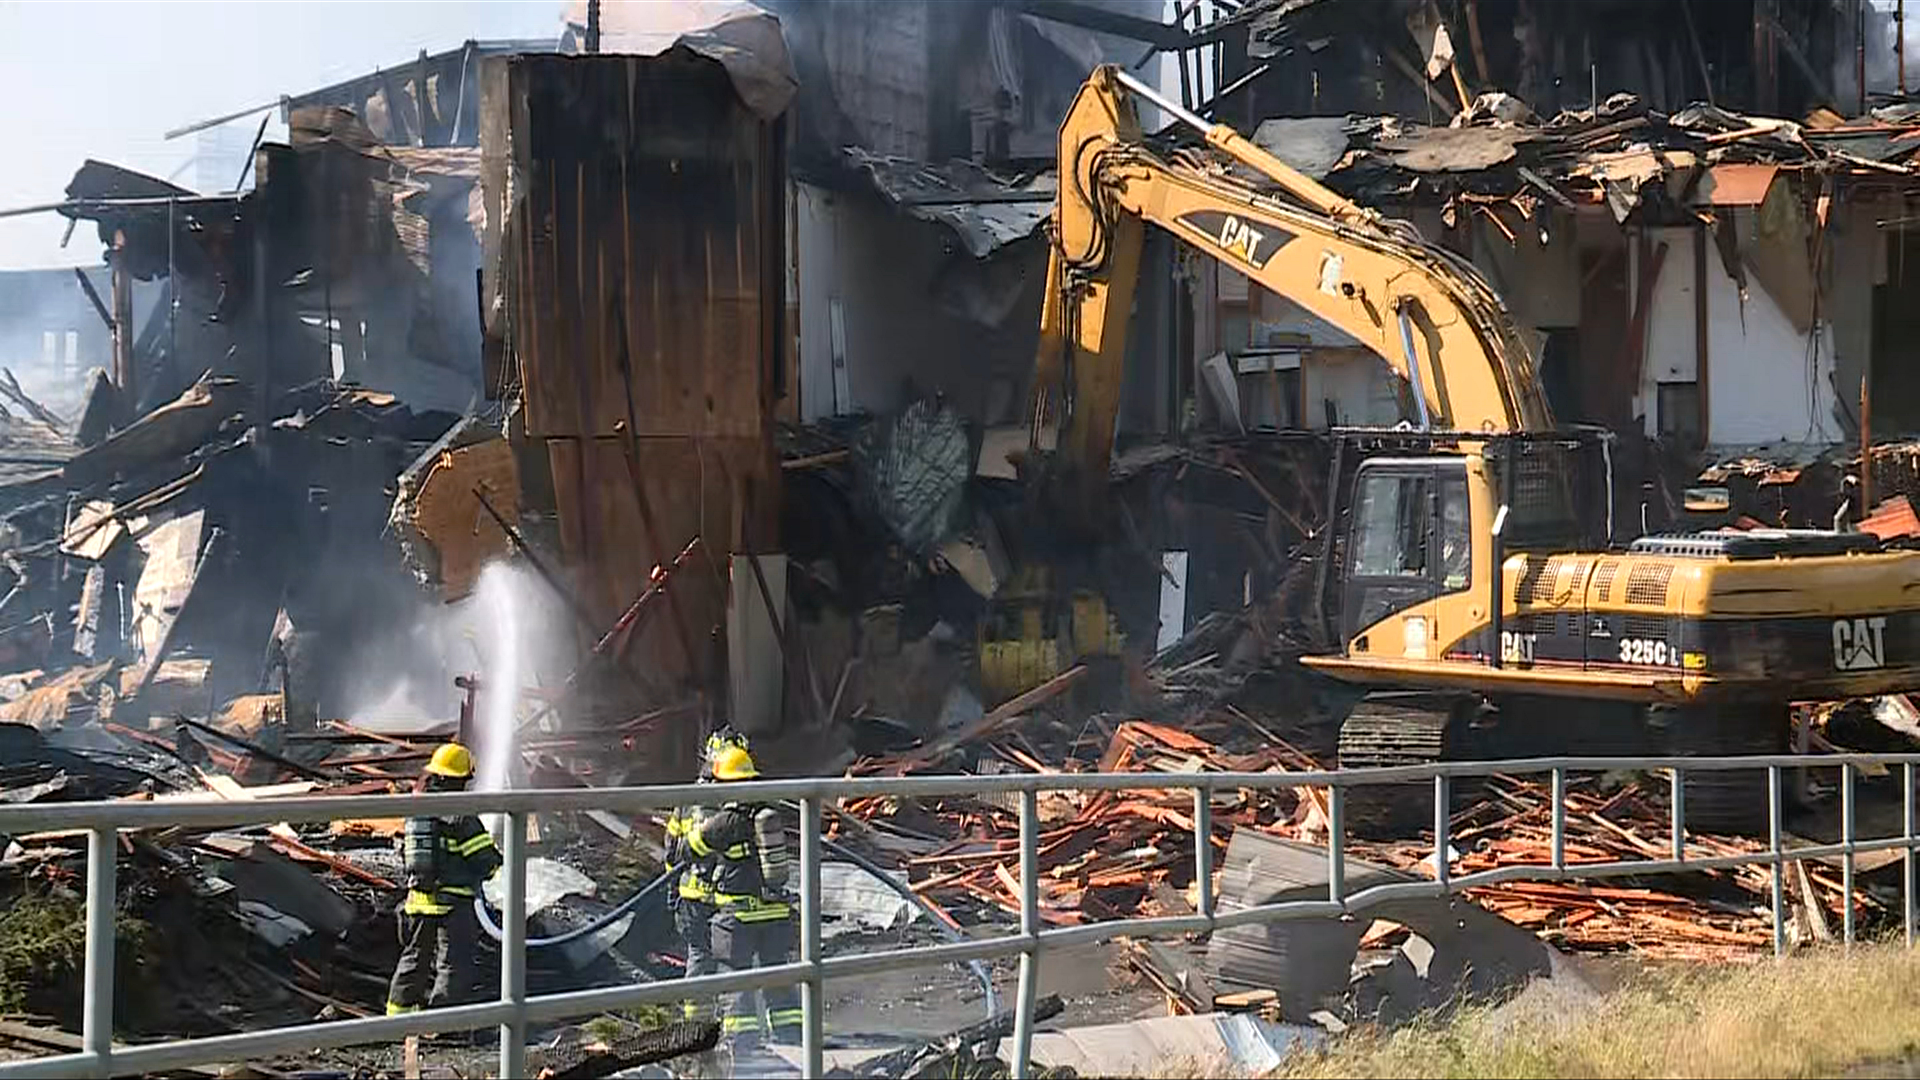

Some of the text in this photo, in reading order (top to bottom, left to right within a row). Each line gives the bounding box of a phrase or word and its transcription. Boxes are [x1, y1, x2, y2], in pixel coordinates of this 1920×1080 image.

[1219, 214, 1265, 264] CAT
[1501, 631, 1537, 663] CAT
[1619, 638, 1679, 666] 325C L
[1833, 616, 1887, 670] CAT
